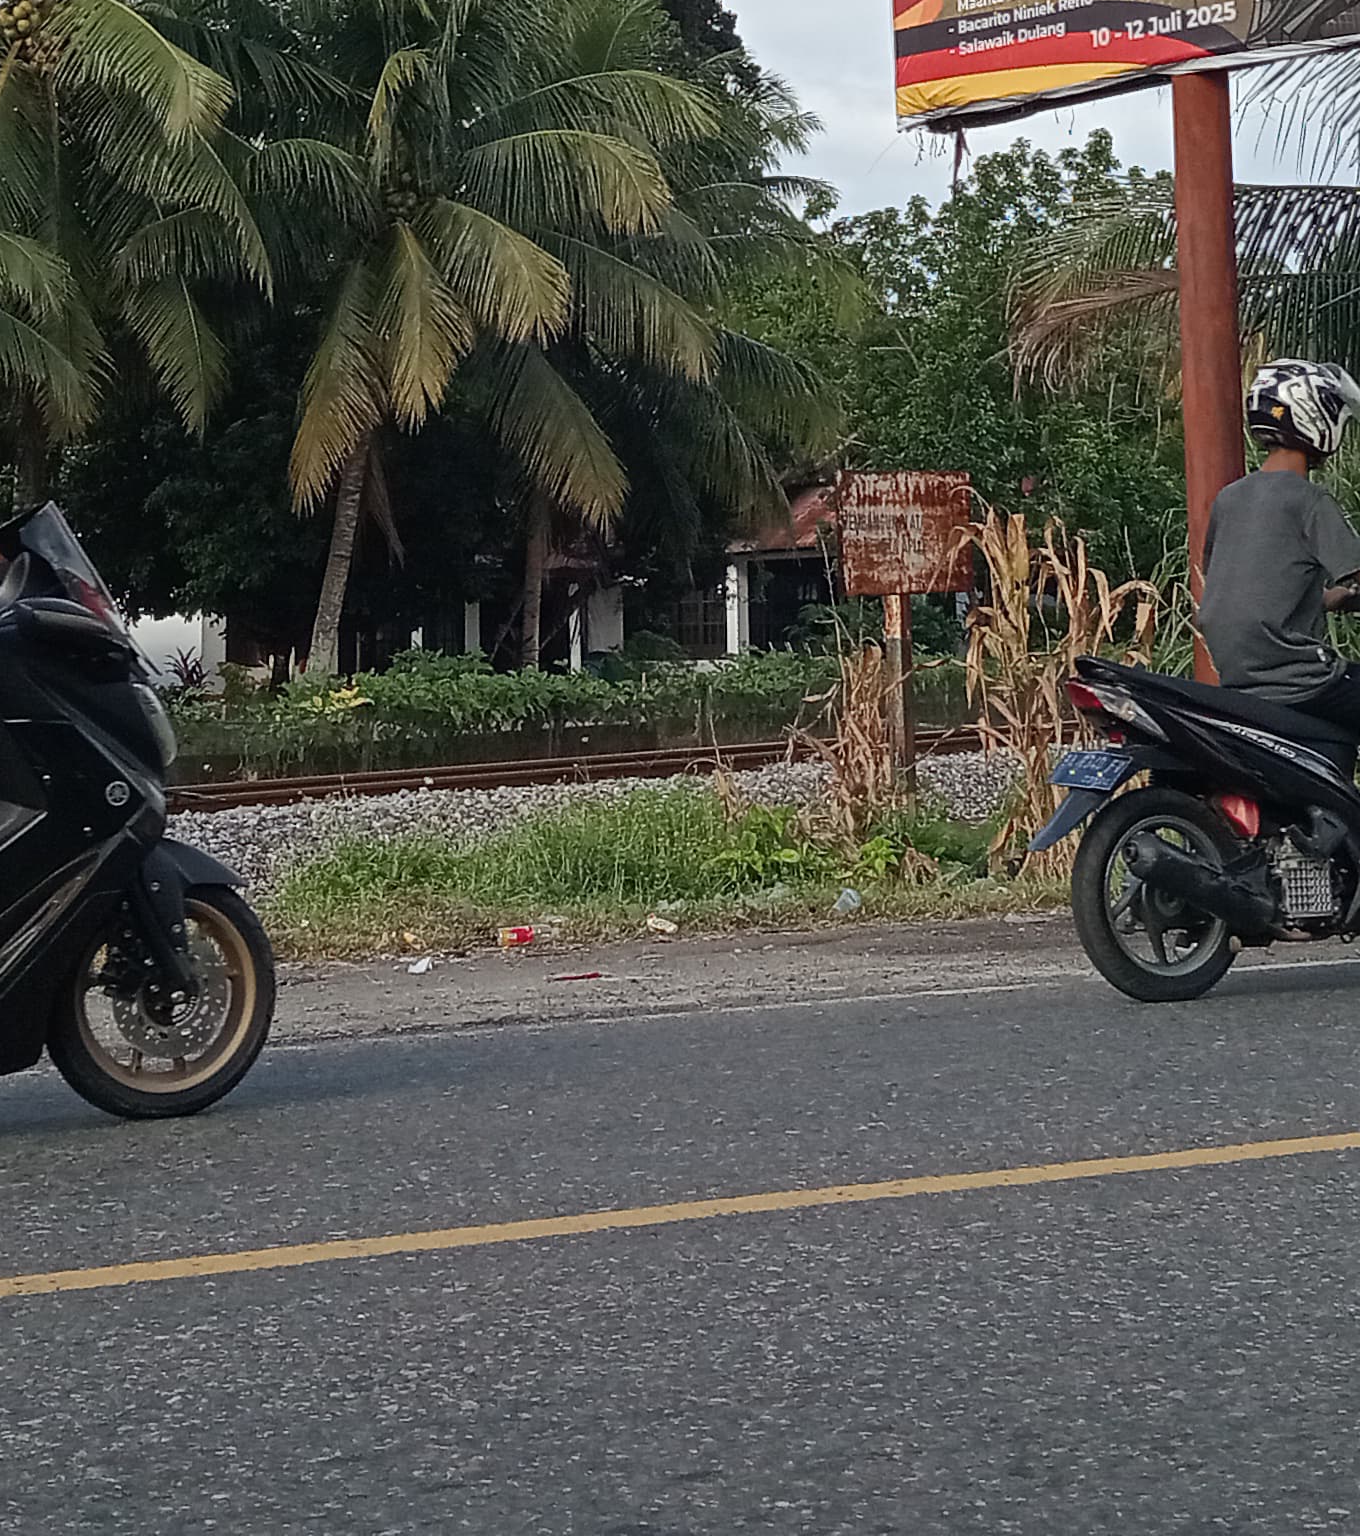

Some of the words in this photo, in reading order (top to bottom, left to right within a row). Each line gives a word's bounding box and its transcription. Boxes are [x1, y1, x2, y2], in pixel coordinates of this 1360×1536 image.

[958, 13, 1010, 34] Bacarito
[1013, 1, 1056, 21] Niniek
[1090, 27, 1110, 48] 10
[1125, 19, 1144, 40] 12
[1148, 9, 1182, 36] Juli
[1186, 0, 1237, 29] 2025
[959, 34, 1015, 56] Salawaik
[1017, 21, 1066, 42] Dulang
